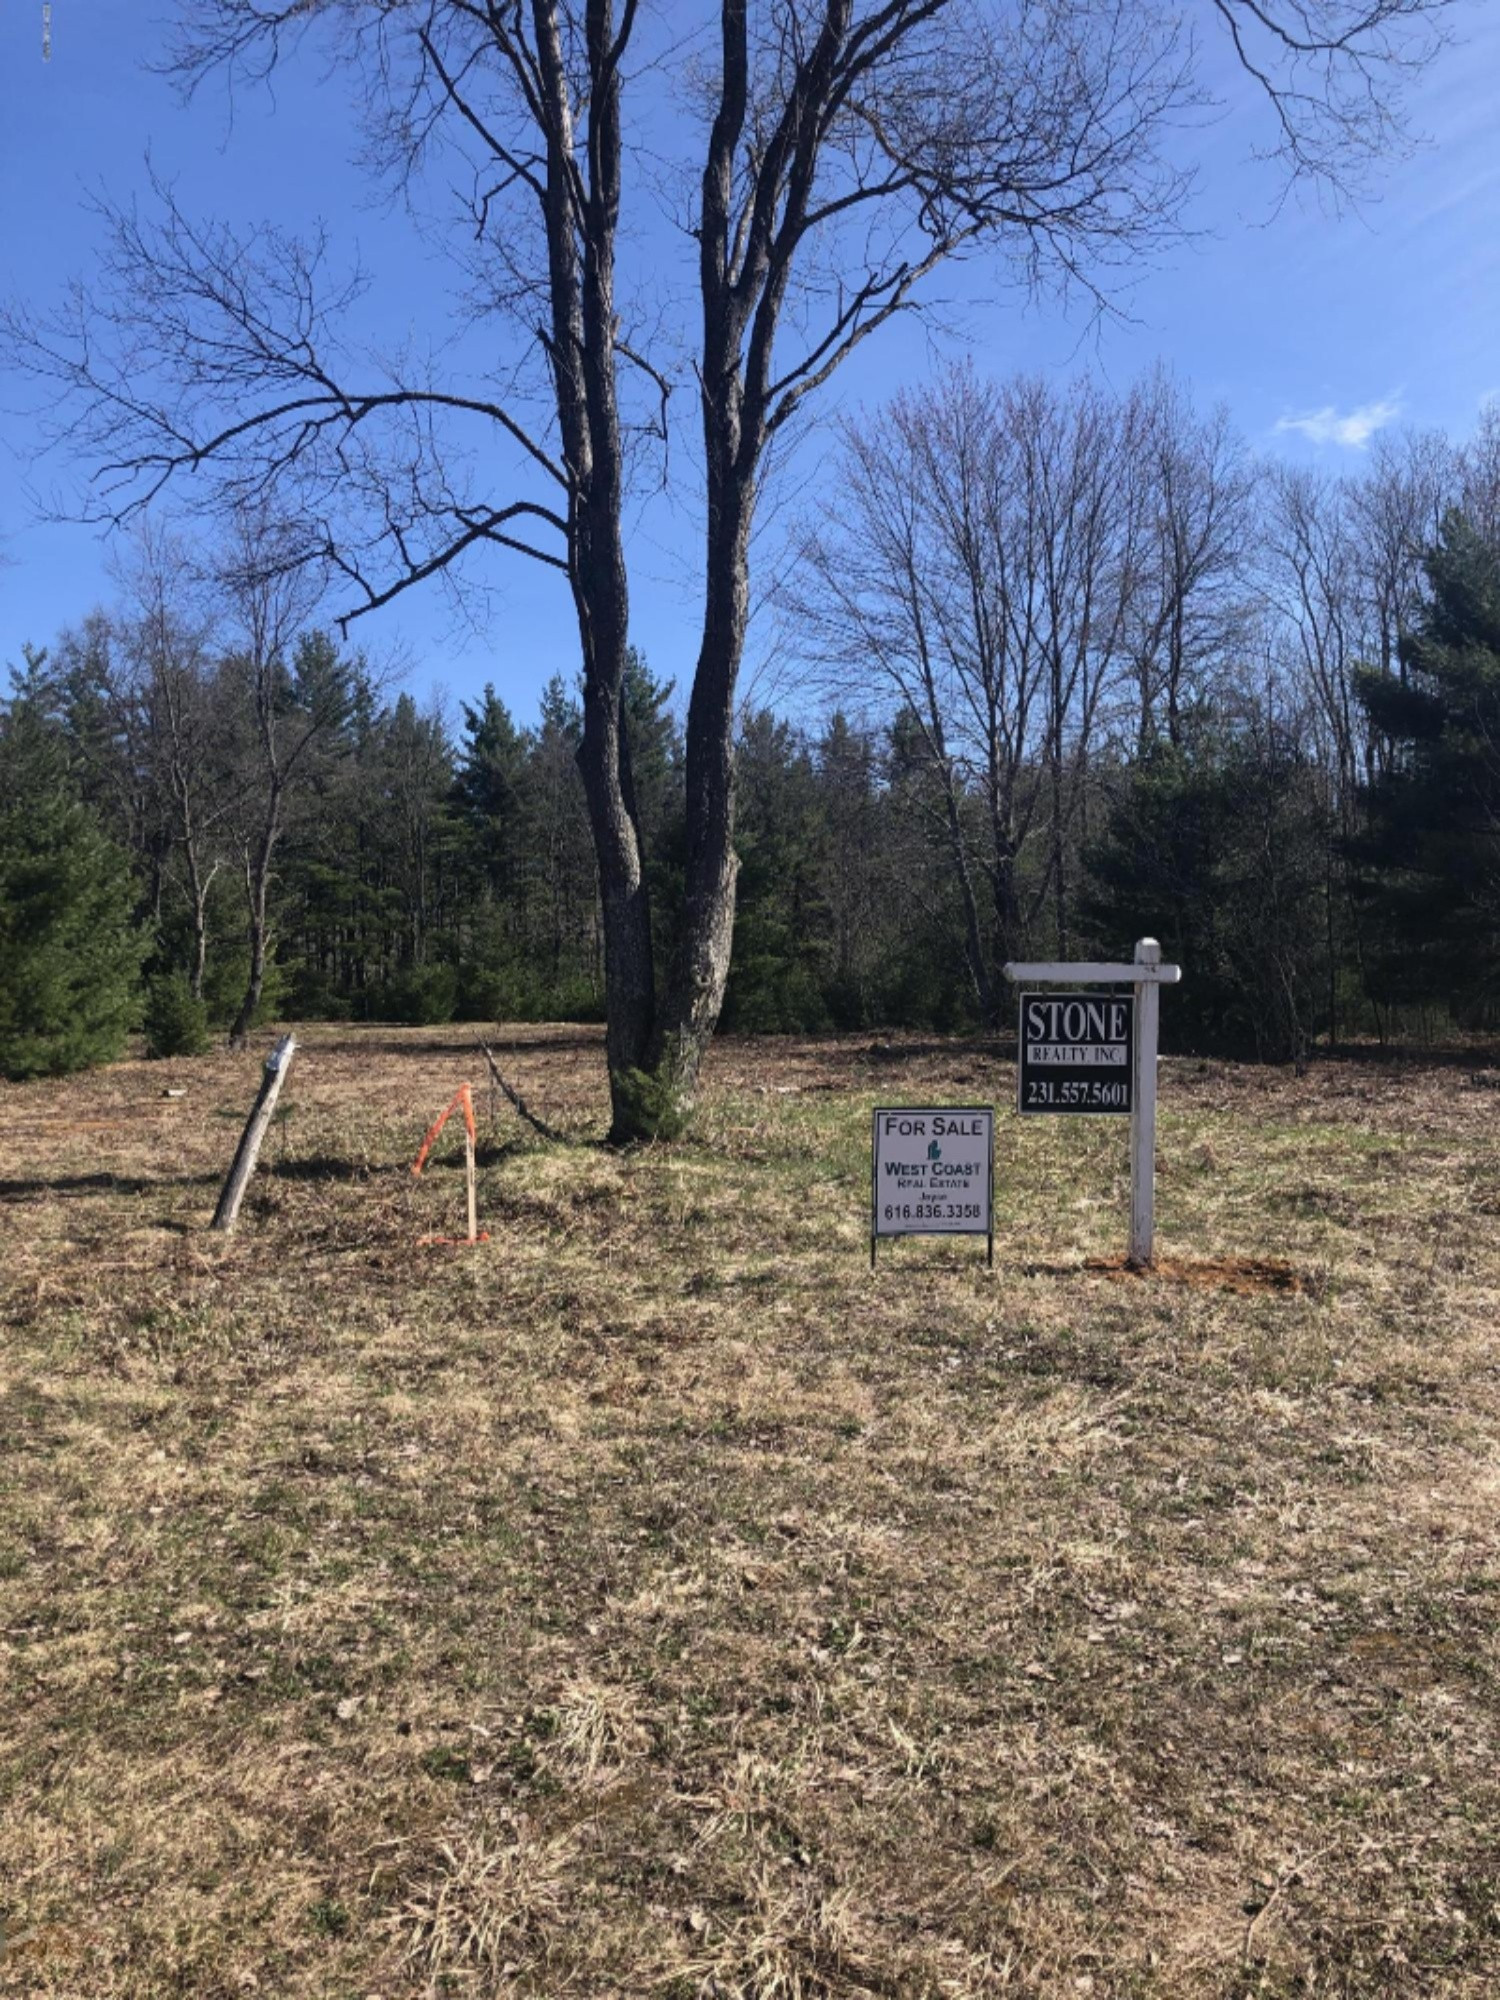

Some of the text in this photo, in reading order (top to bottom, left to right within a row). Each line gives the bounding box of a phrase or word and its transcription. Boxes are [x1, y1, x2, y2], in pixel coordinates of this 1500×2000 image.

[1026, 1002, 1128, 1041] STONE
[1027, 1081, 1128, 1105] 231.557.5601
[885, 1117, 984, 1136] FOR SALE
[884, 1162, 981, 1177] WEST COAST
[897, 1177, 970, 1189] REAL ESTATE
[884, 1204, 981, 1220] 616.836.3358
